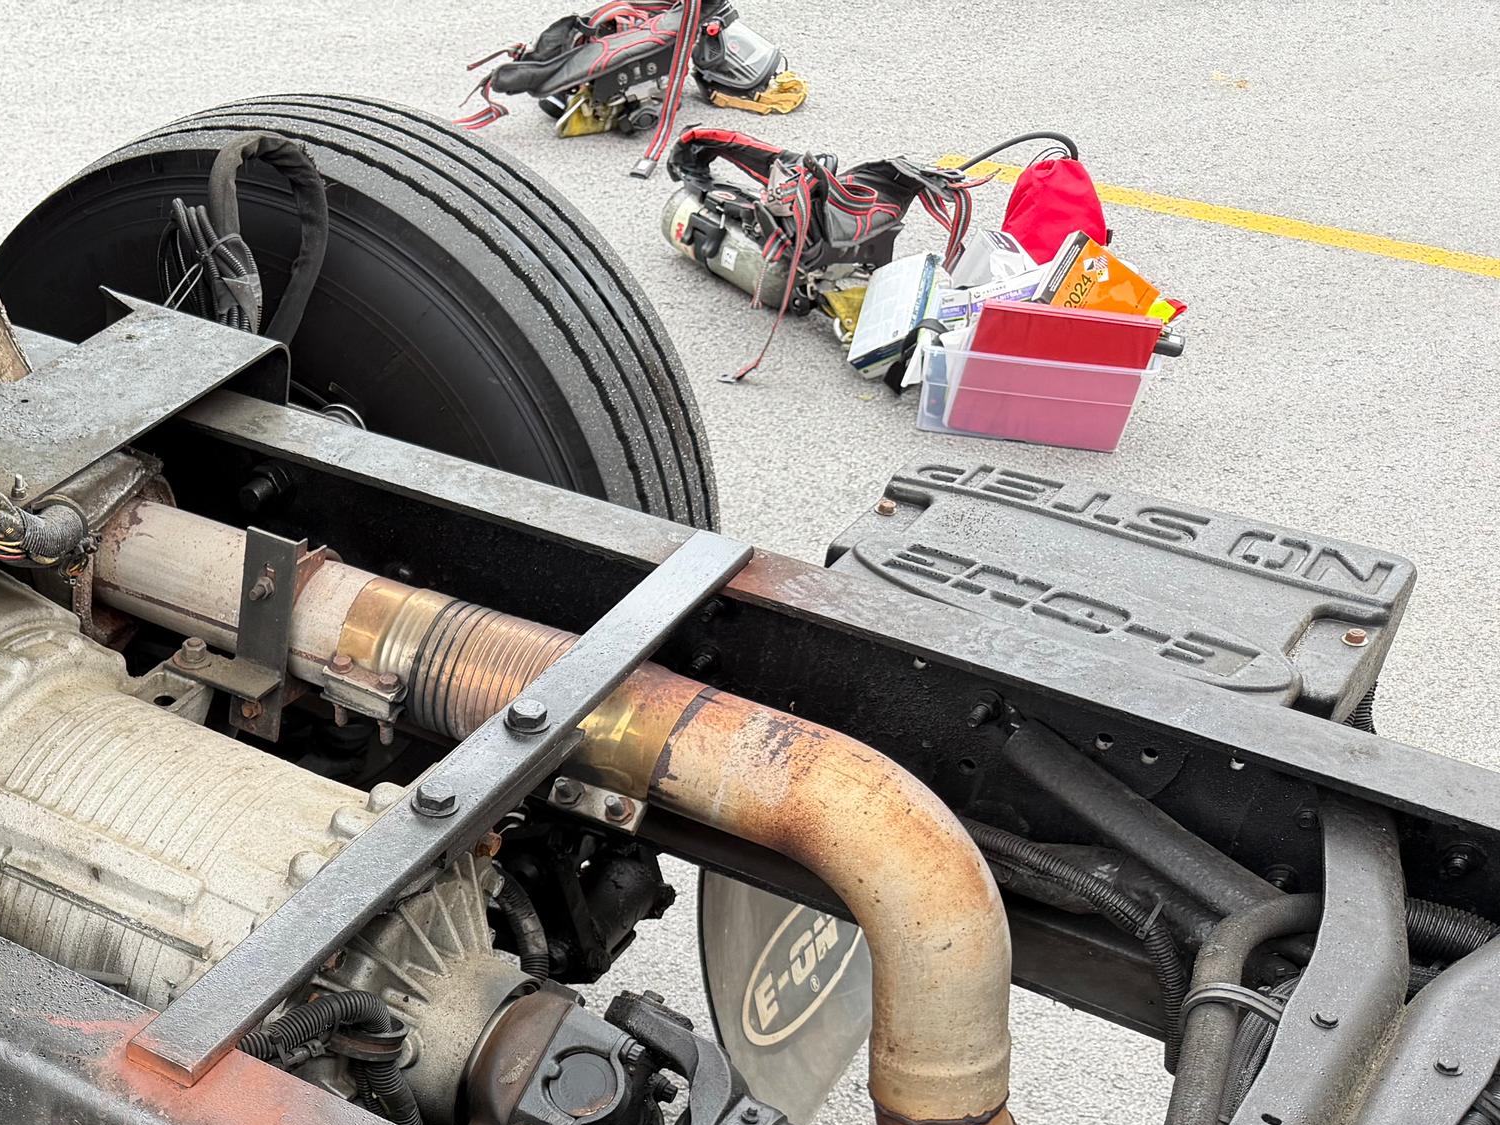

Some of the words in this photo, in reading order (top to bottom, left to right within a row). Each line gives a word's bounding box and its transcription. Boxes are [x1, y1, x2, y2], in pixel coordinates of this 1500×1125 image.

[1063, 273, 1093, 309] 2024
[916, 463, 1212, 544] STEP
[1227, 529, 1398, 597] NO
[753, 914, 839, 1032] E-ON
